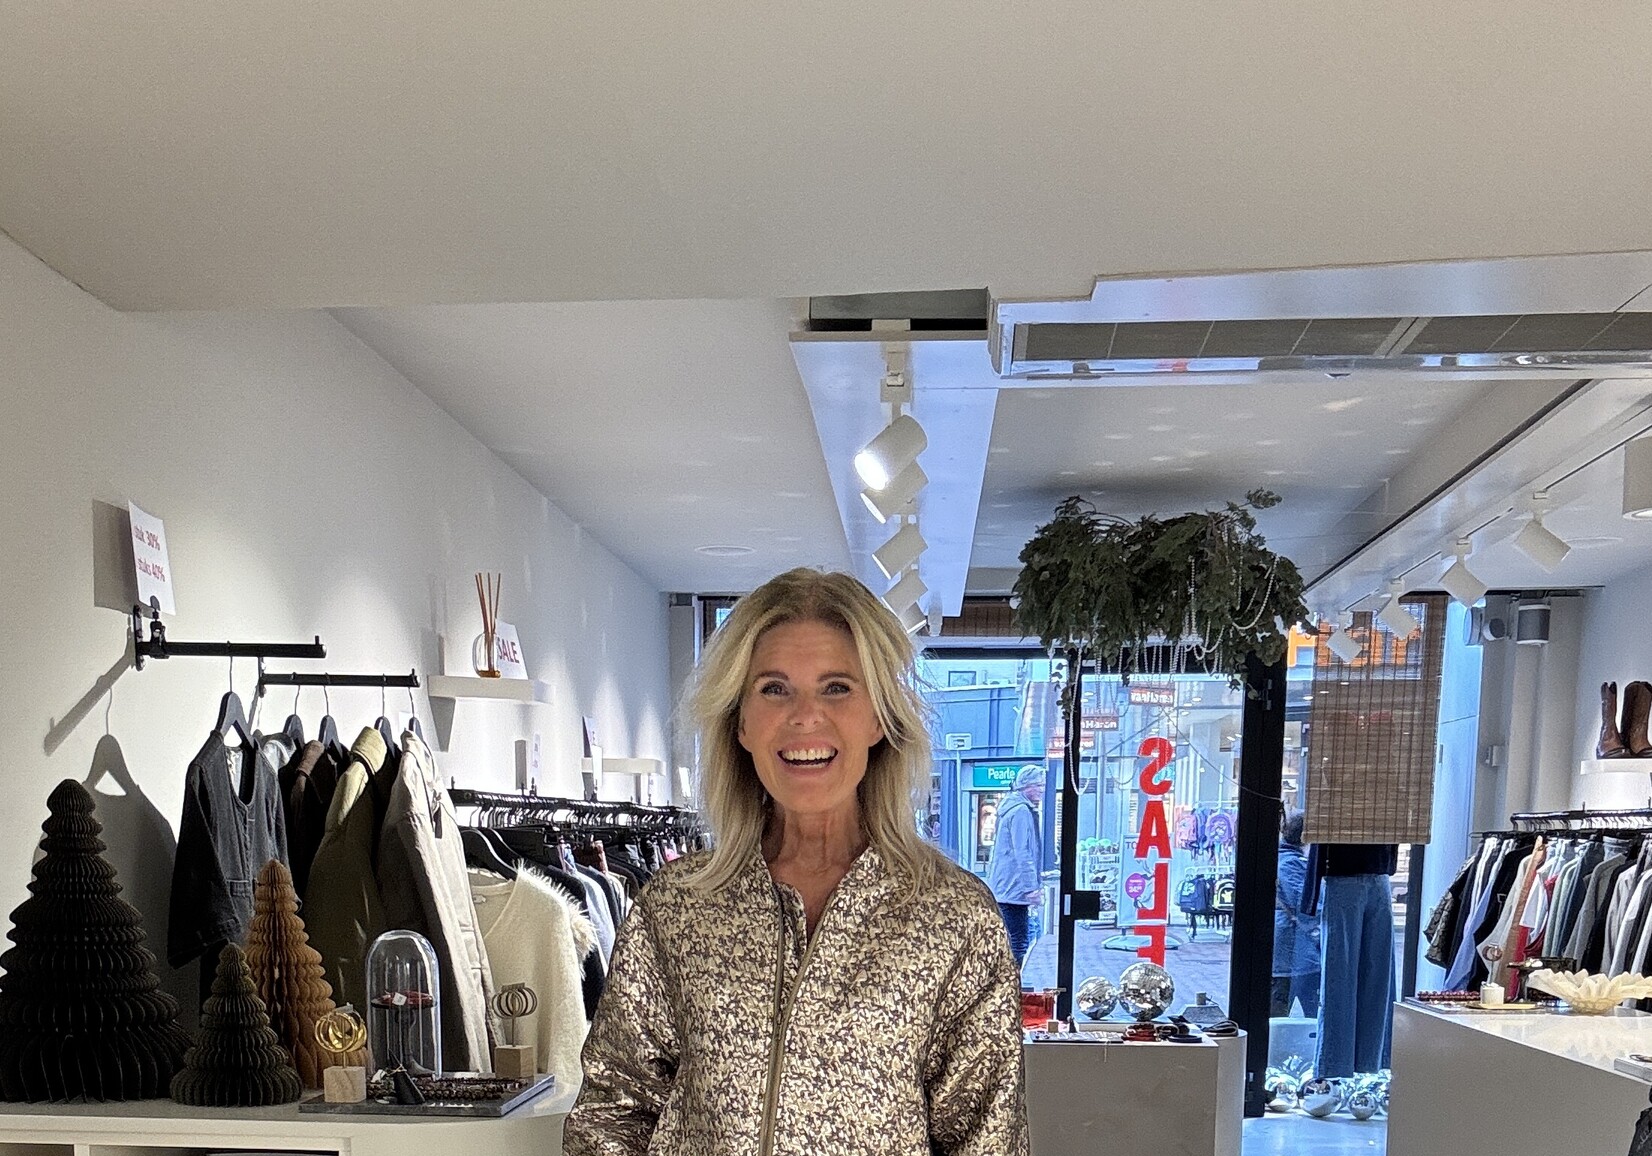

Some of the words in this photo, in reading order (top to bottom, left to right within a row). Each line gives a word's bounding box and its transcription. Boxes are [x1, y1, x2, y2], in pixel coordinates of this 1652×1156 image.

[146, 530, 160, 550] 30%
[152, 563, 165, 582] 40%
[496, 636, 520, 664] SALE
[987, 767, 1016, 780] Pearle
